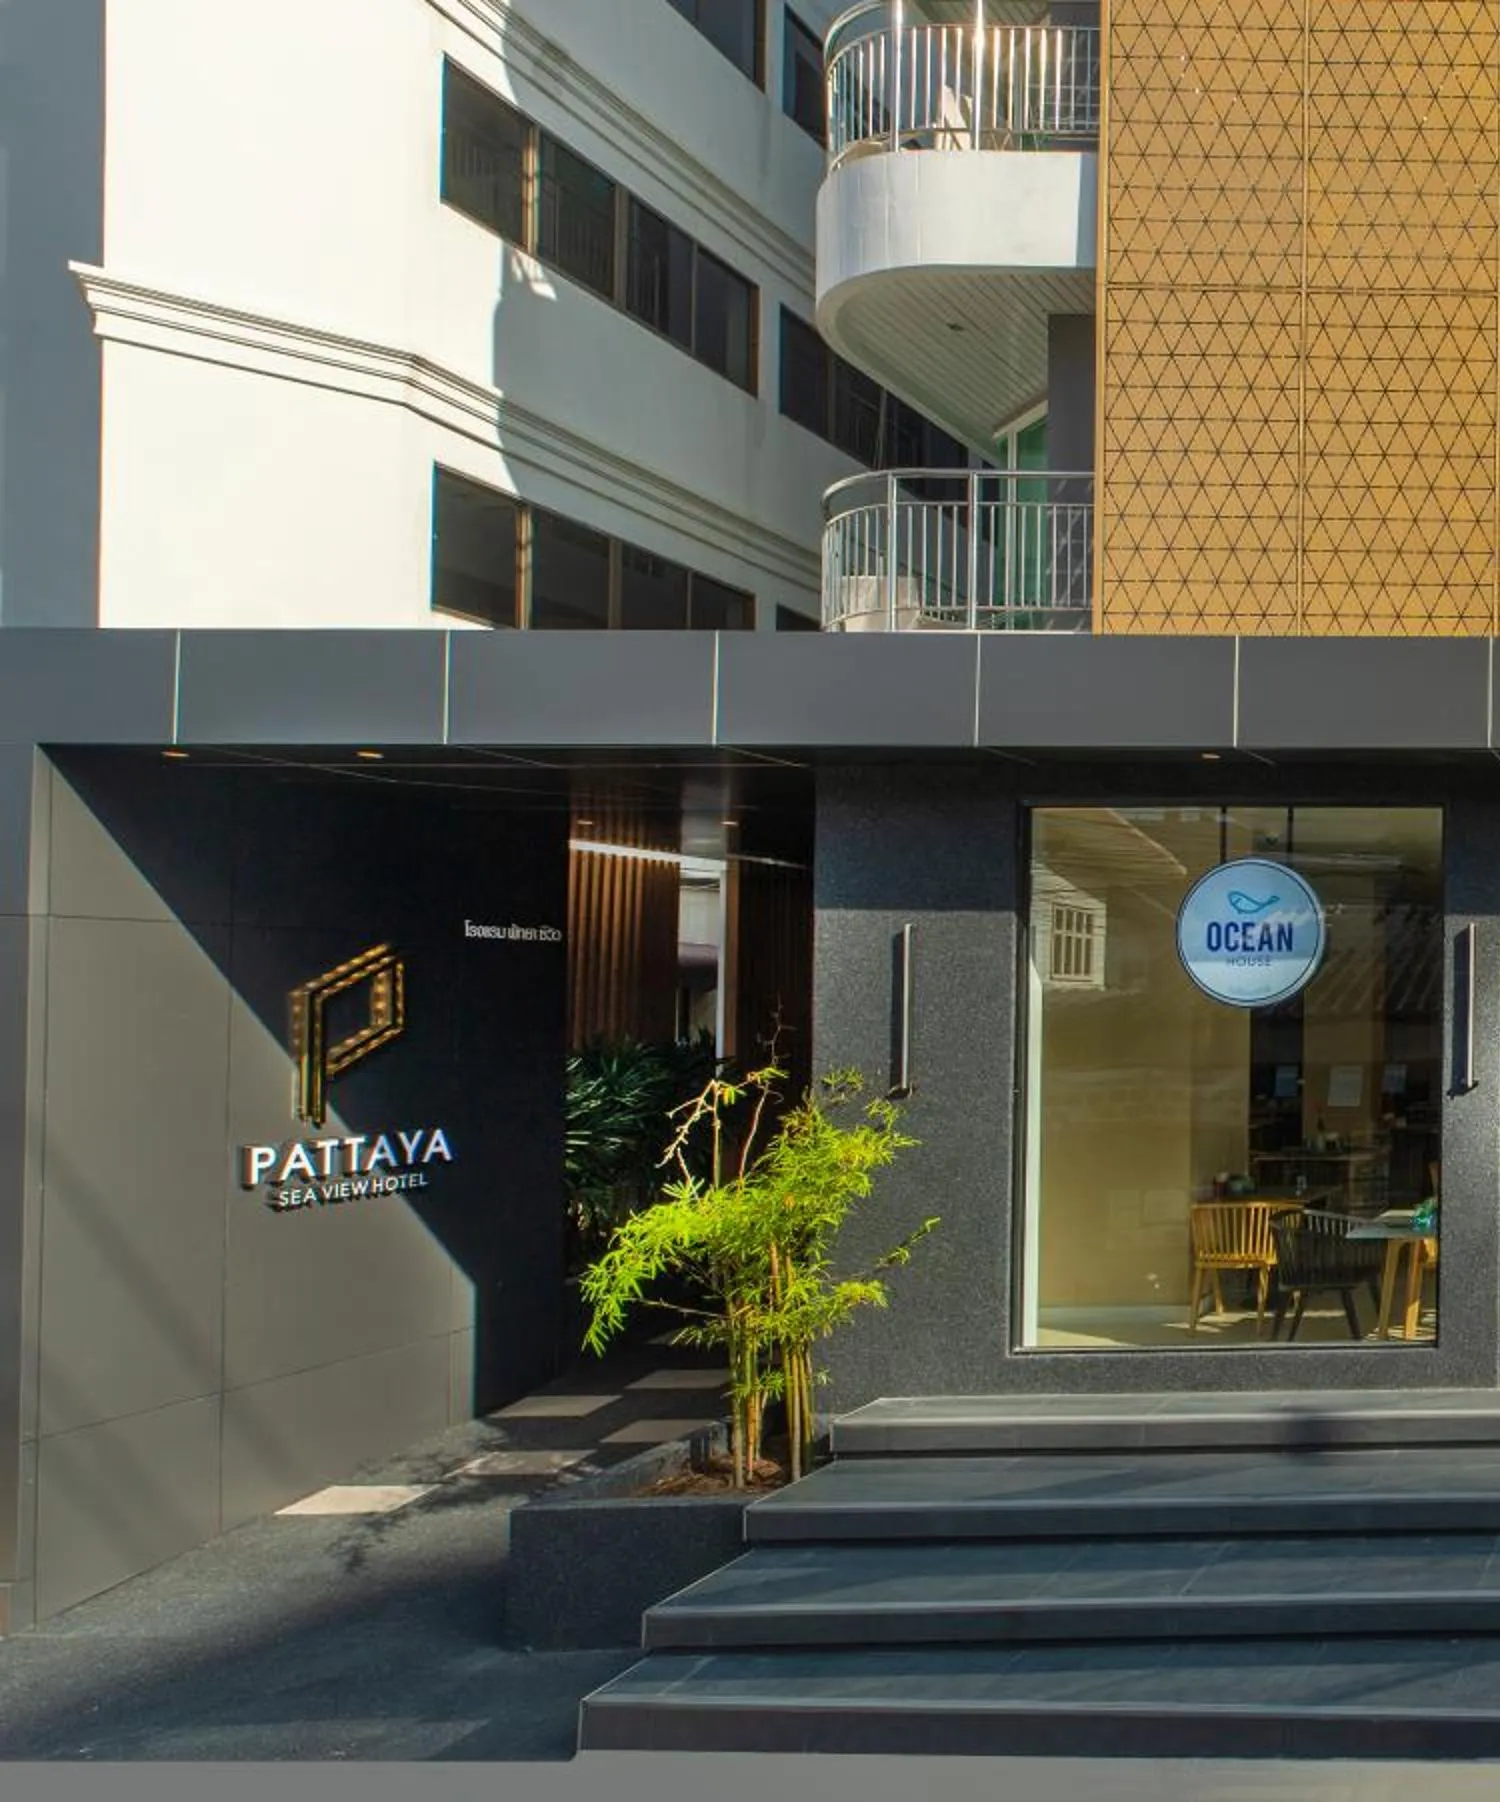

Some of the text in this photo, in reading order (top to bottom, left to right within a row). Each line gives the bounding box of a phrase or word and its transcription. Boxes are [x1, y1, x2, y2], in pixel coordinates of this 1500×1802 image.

[1206, 921, 1293, 952] OCEAN
[1226, 954, 1272, 967] HOUSE
[246, 1128, 453, 1187] PATTAYA
[277, 1173, 429, 1208] SEA VIEW HOTEL
